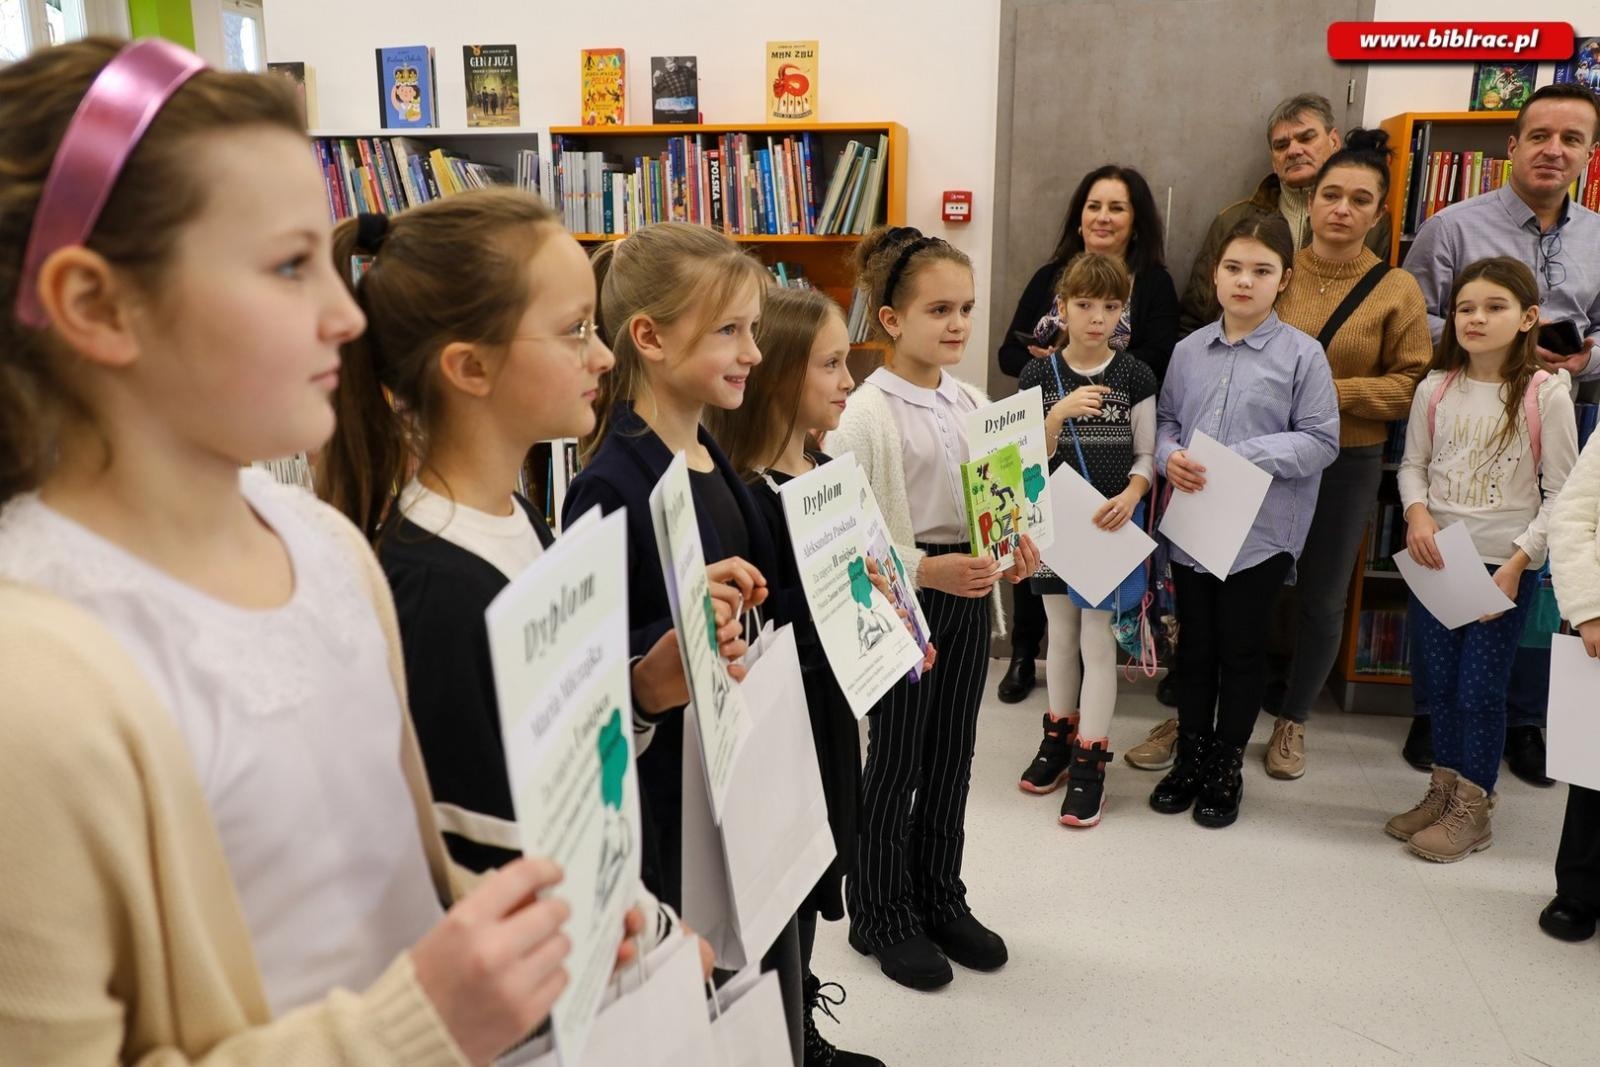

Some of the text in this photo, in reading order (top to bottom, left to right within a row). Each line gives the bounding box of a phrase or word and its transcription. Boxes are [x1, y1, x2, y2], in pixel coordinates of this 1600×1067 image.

[711, 160, 720, 200] POLSKA
[985, 409, 1025, 433] Dyplom
[803, 481, 843, 517] Dyplom
[524, 573, 595, 664] Dyplom
